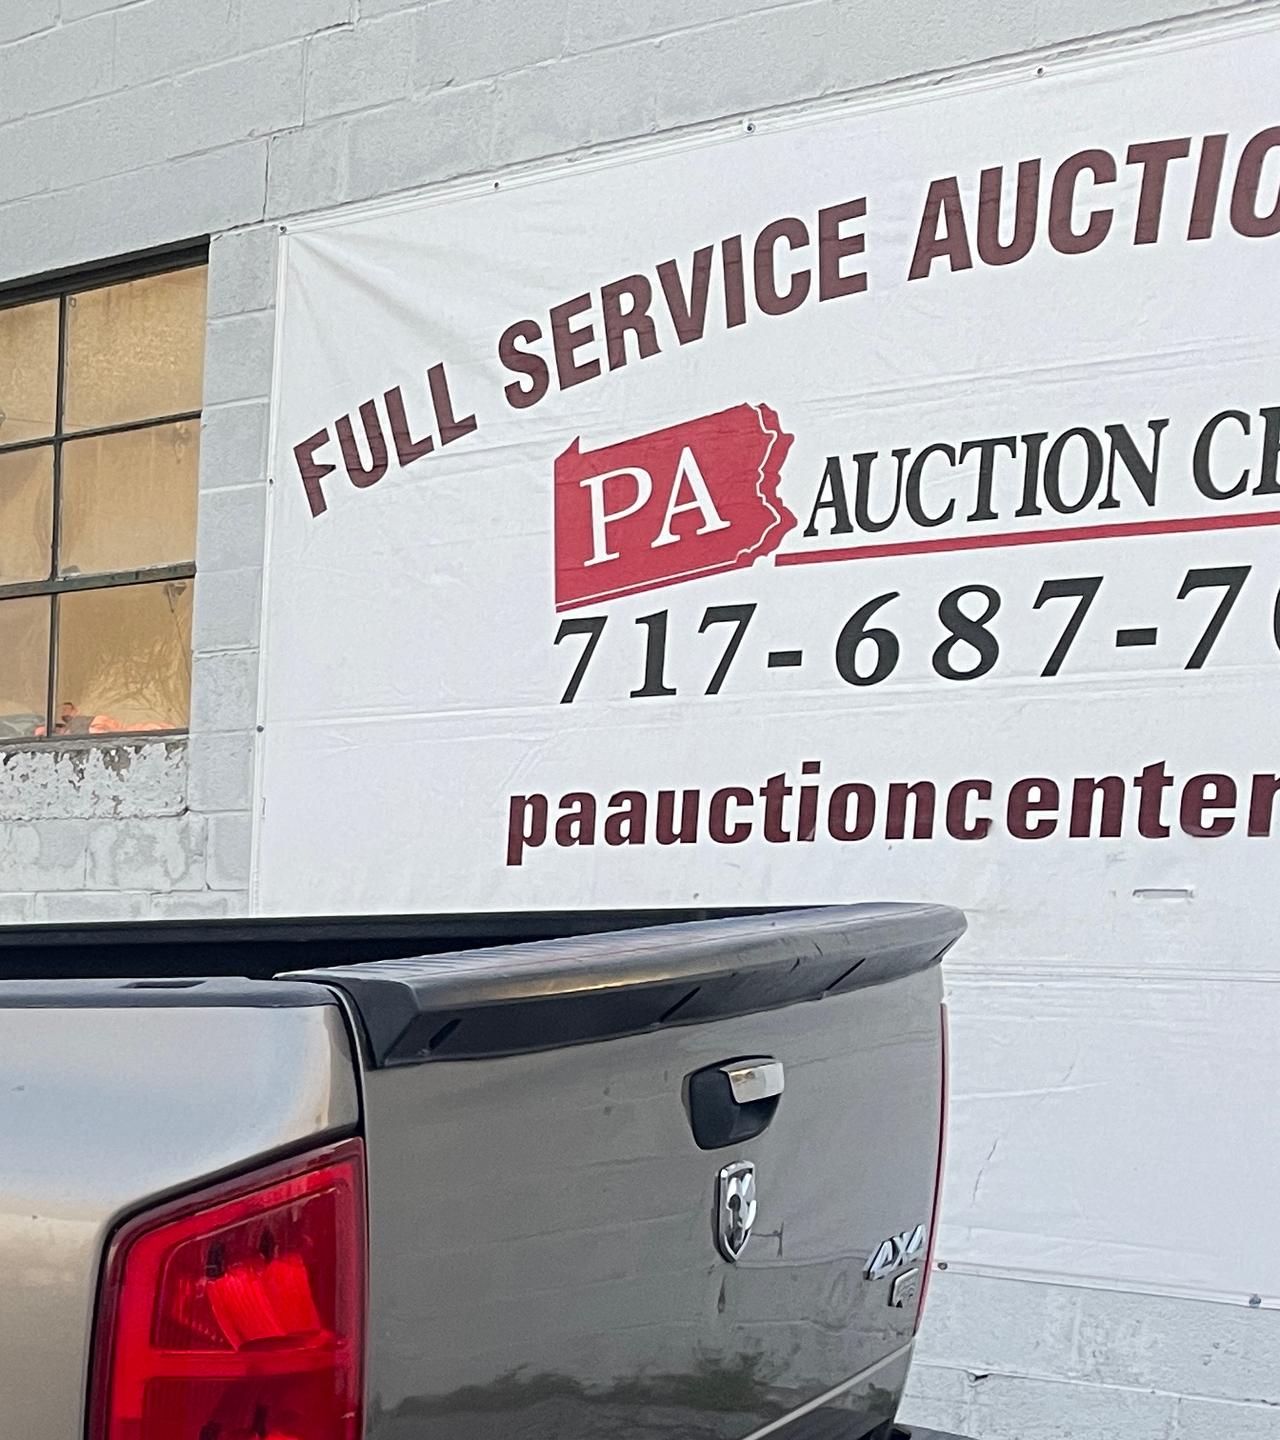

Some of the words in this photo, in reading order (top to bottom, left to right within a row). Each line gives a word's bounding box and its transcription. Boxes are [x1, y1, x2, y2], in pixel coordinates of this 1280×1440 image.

[293, 363, 477, 517] FULL
[499, 197, 867, 408] SERVICE
[908, 126, 1280, 281] AUCTIO
[579, 447, 731, 567] PA
[803, 419, 1169, 537] AUCTION
[554, 566, 1280, 704] 717-687-7
[507, 761, 1280, 866] paauctioncenter
